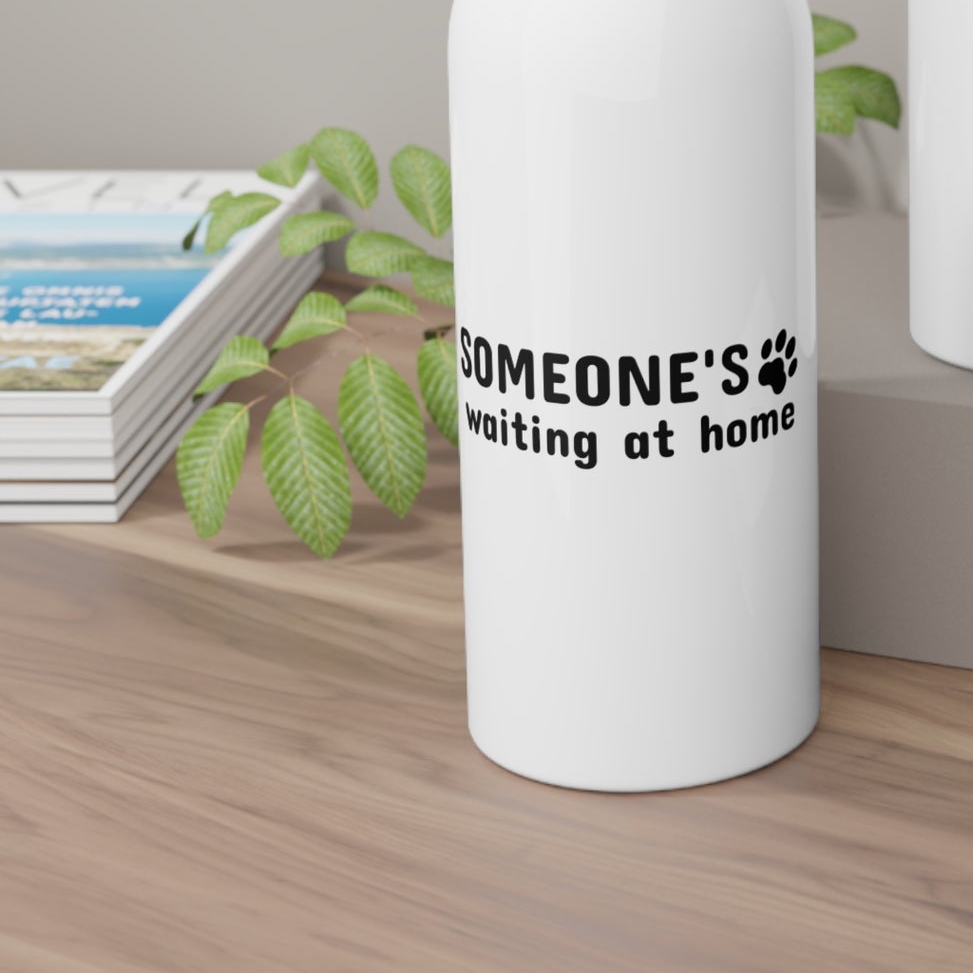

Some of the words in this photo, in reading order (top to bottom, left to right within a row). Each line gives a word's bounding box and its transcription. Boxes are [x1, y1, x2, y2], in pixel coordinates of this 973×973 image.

[460, 326, 749, 407] SOMEONE'S
[465, 401, 598, 470] waiting
[624, 420, 675, 460] at
[700, 402, 796, 454] home
